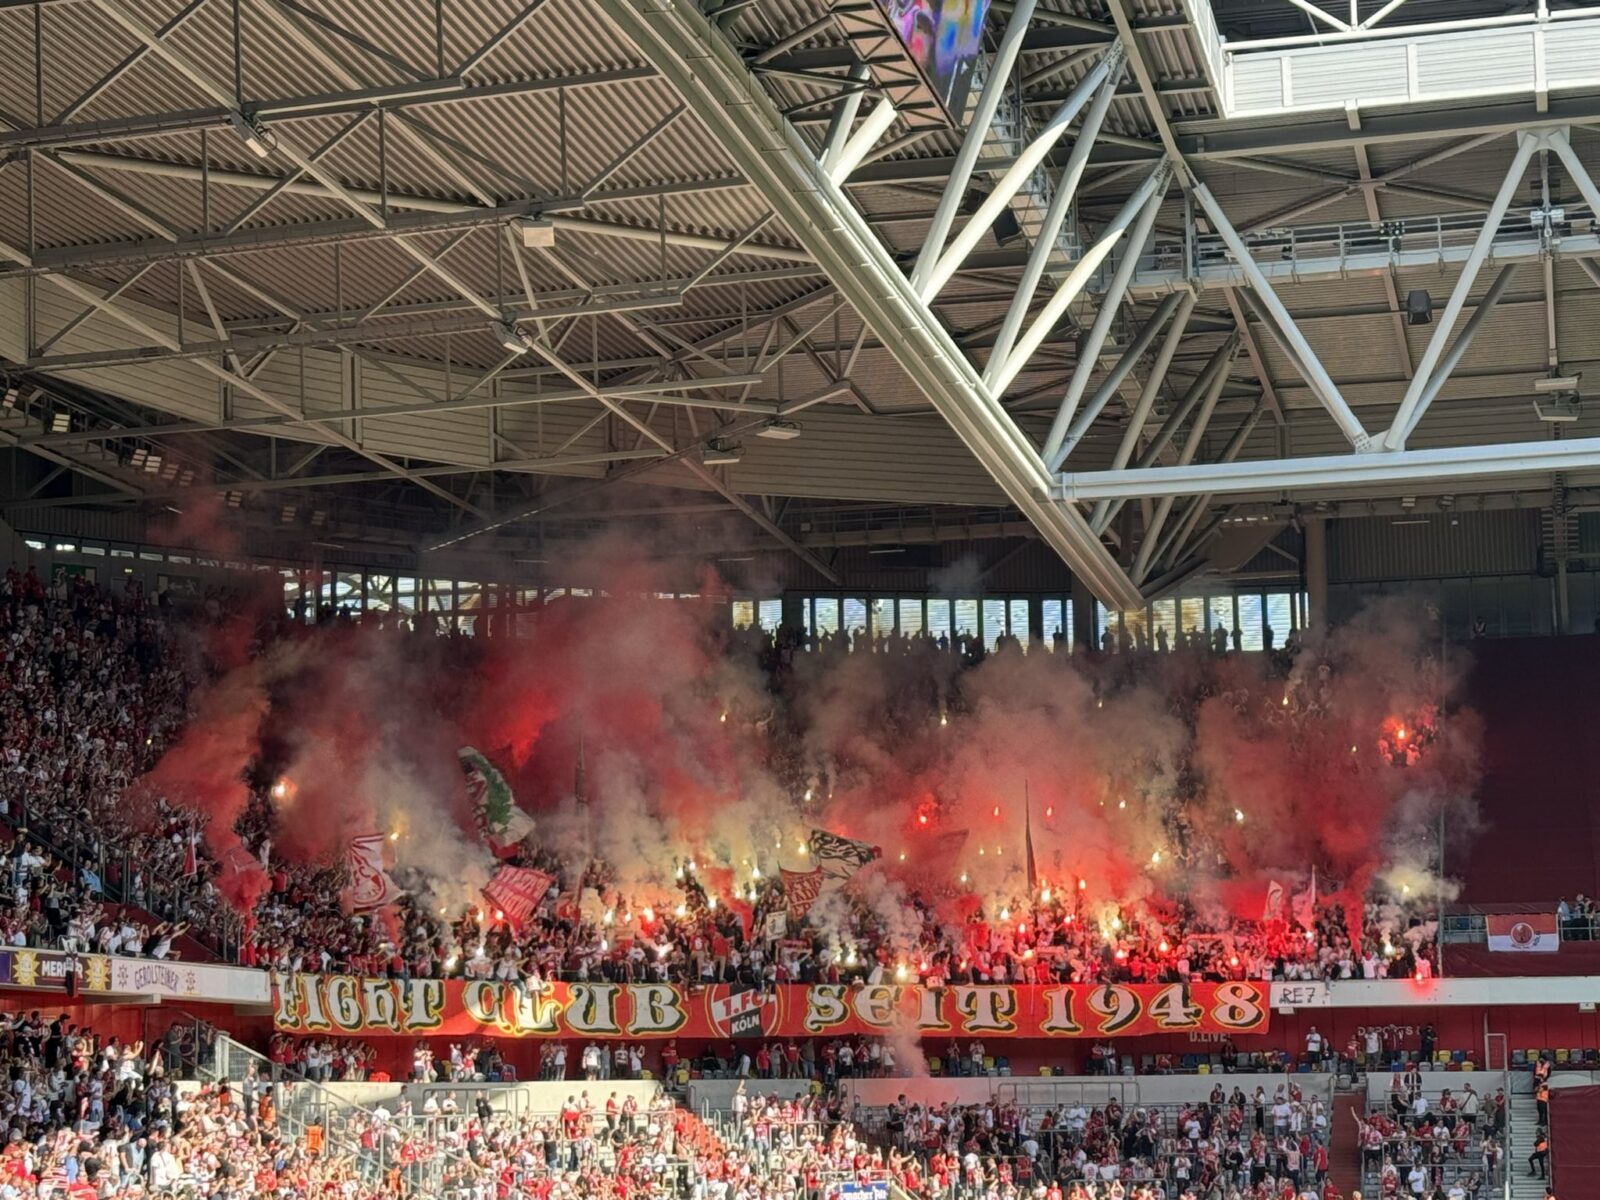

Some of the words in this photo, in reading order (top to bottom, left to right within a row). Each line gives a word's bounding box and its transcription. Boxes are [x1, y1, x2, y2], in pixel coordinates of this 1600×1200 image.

[42, 960, 83, 979] MERR
[462, 979, 689, 1037] CLUB
[732, 1015, 760, 1035] KÖLN
[804, 984, 1018, 1032] SEIT
[1040, 981, 1266, 1033] 1948
